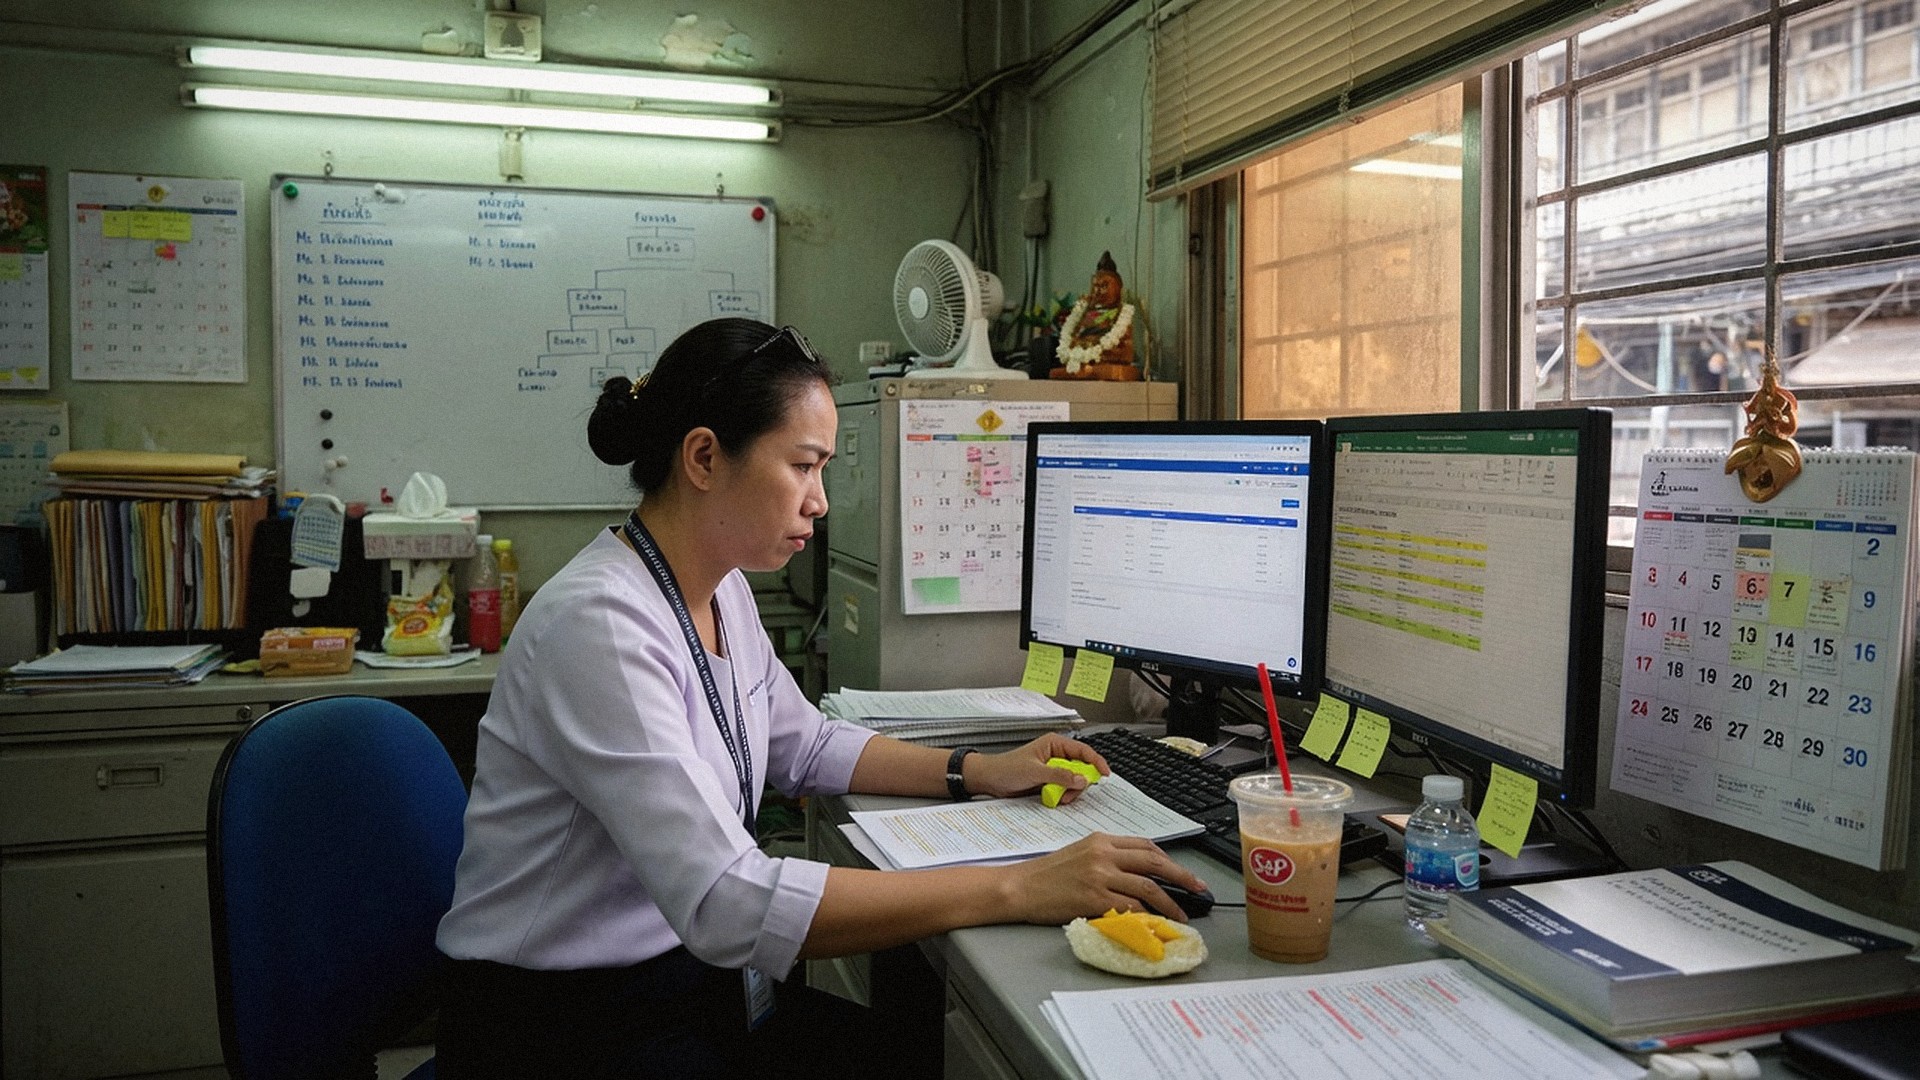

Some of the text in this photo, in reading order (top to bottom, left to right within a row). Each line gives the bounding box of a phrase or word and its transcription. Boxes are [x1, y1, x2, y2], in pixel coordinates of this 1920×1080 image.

[1867, 538, 1881, 557] 2
[1679, 571, 1687, 586] 4
[1712, 575, 1722, 591] 5
[1747, 578, 1757, 595] 6
[1784, 582, 1795, 598] 7
[1865, 591, 1876, 609] 9
[1642, 612, 1876, 663] 10 11 12 13 14 15 16
[1637, 656, 1872, 715] 17 18 19 20 21 22 23
[1632, 700, 1868, 768] 24 25 26 27 28 29 30
